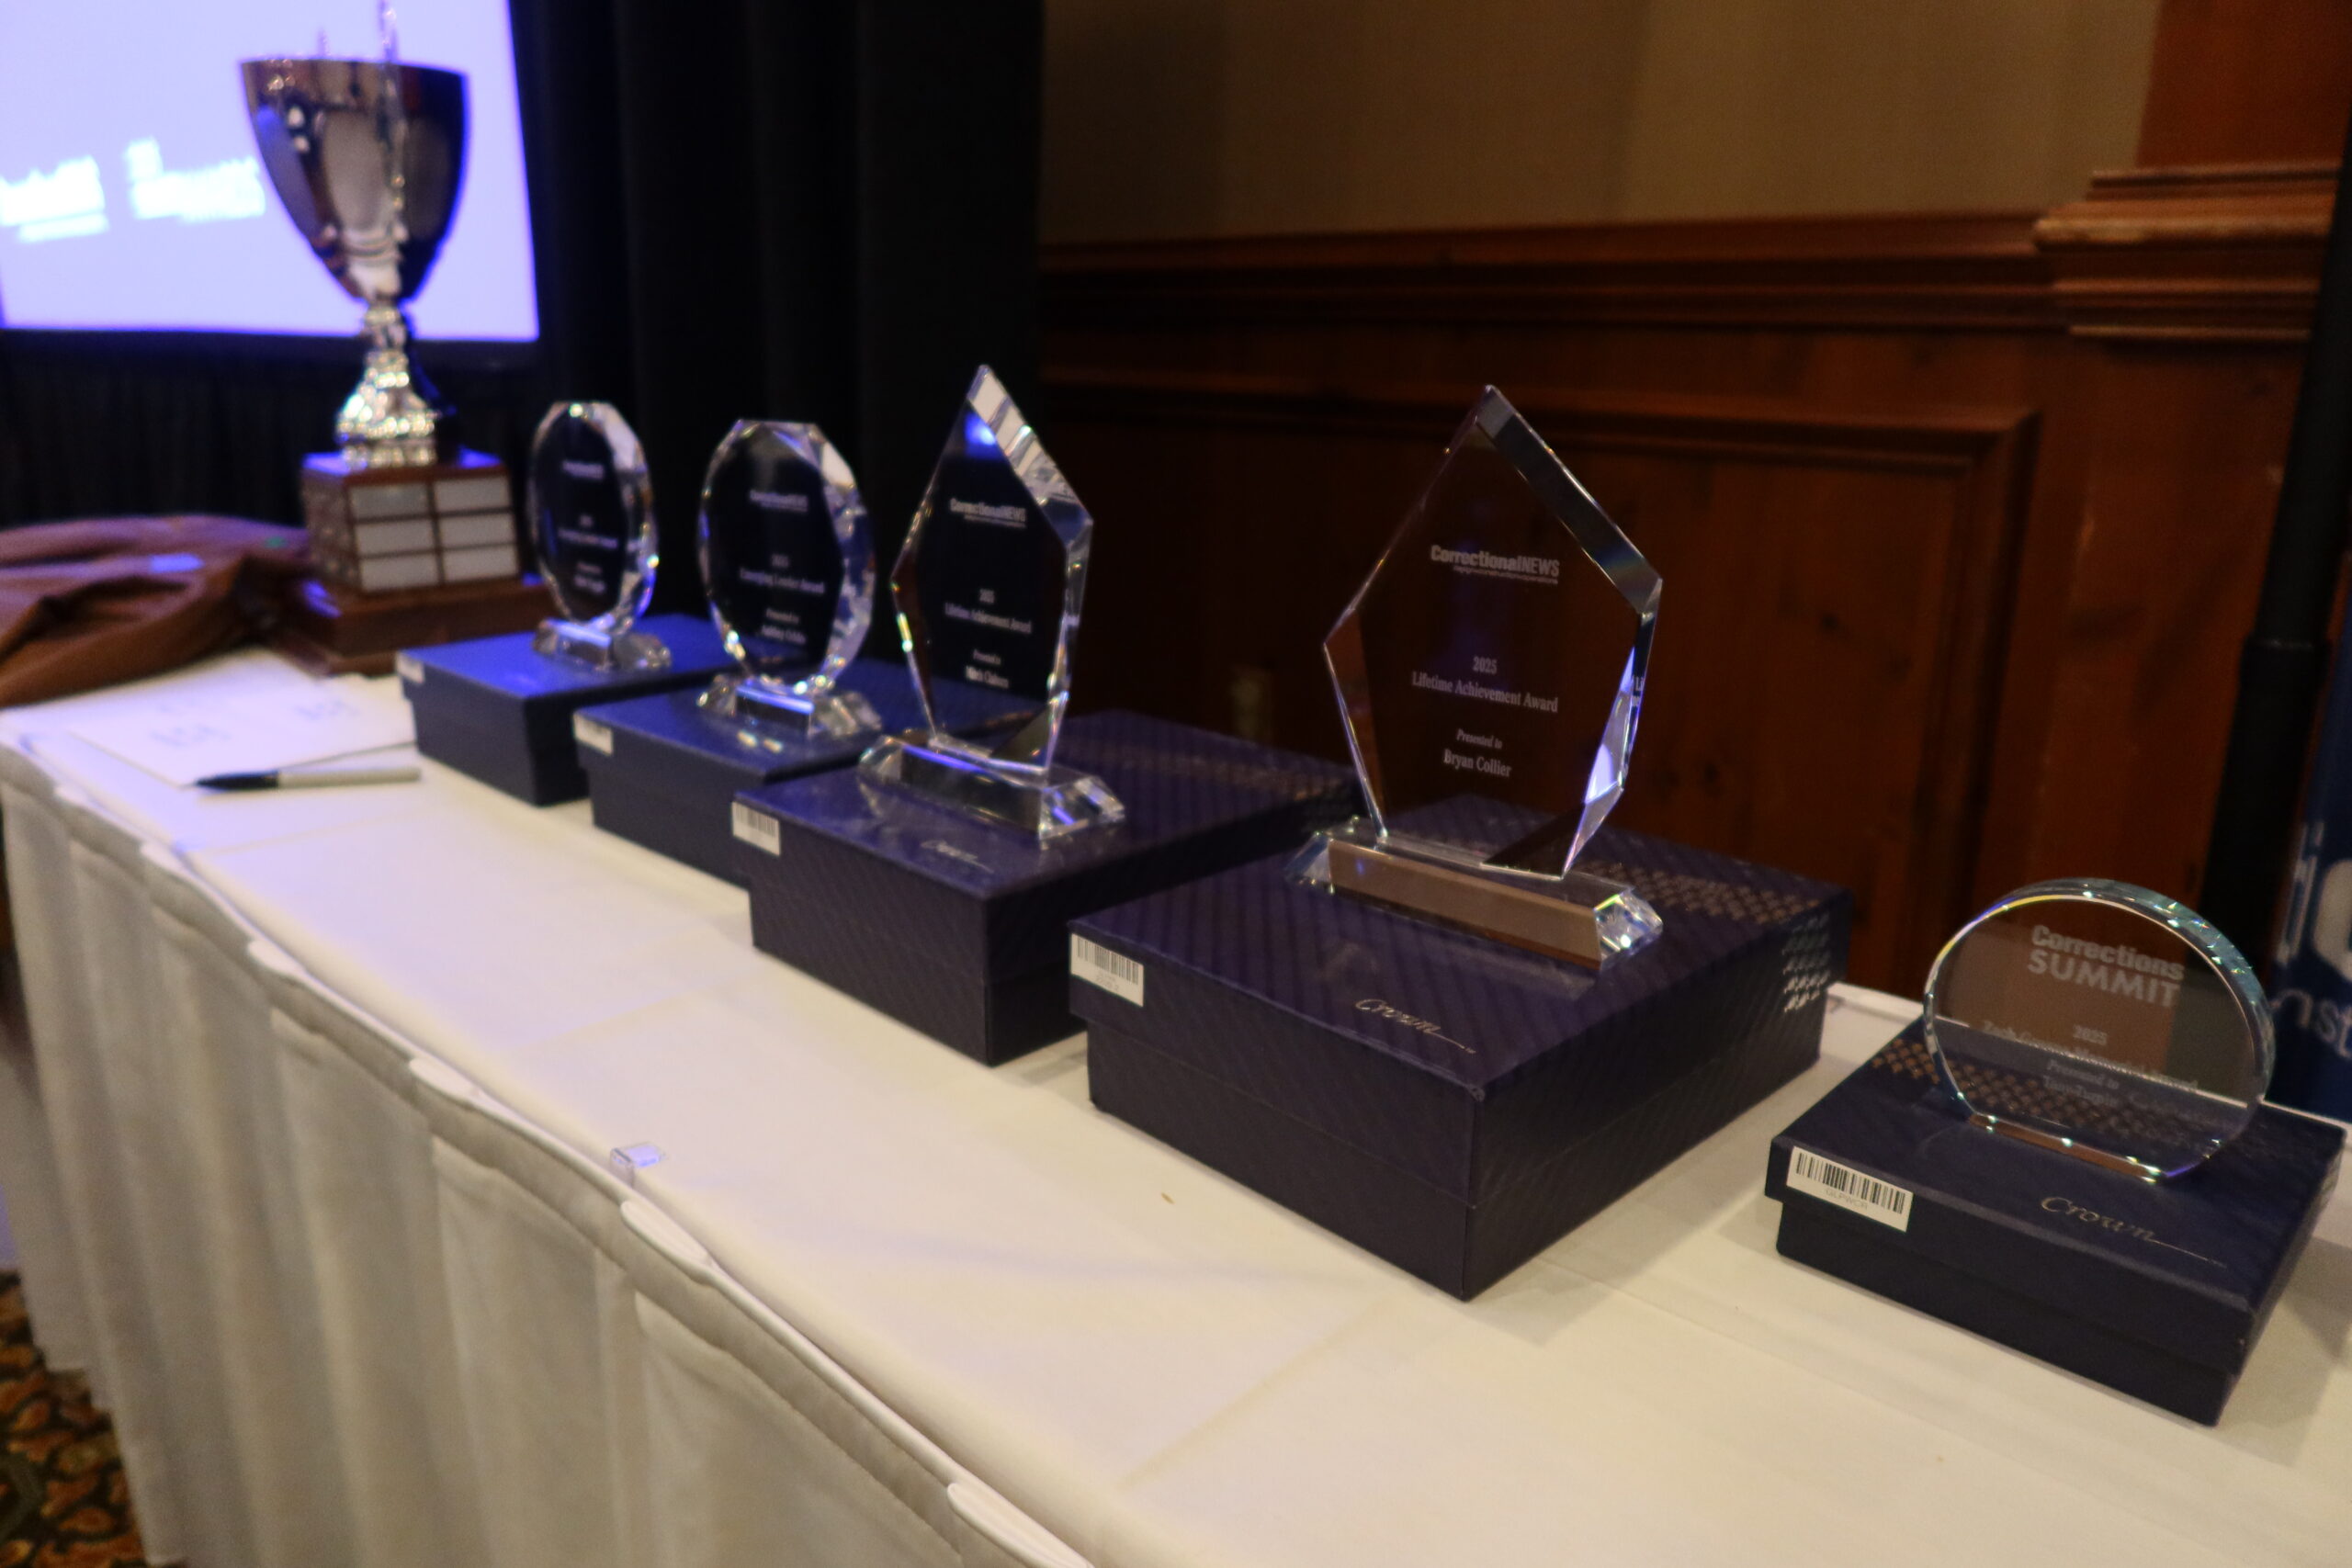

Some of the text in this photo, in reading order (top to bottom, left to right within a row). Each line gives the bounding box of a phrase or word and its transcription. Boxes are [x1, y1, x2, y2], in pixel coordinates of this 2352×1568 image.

[1430, 545, 1560, 577] CorrectionalNEWS
[1473, 656, 1498, 675] 2025
[1412, 671, 1558, 713] Lifetime Achievement Award
[1456, 728, 1502, 750] Presented to
[1443, 749, 1512, 778] Bryan Collier
[2031, 924, 2185, 981] Corrections
[2028, 949, 2180, 1008] SUMMIT
[2073, 1024, 2108, 1046] 2025
